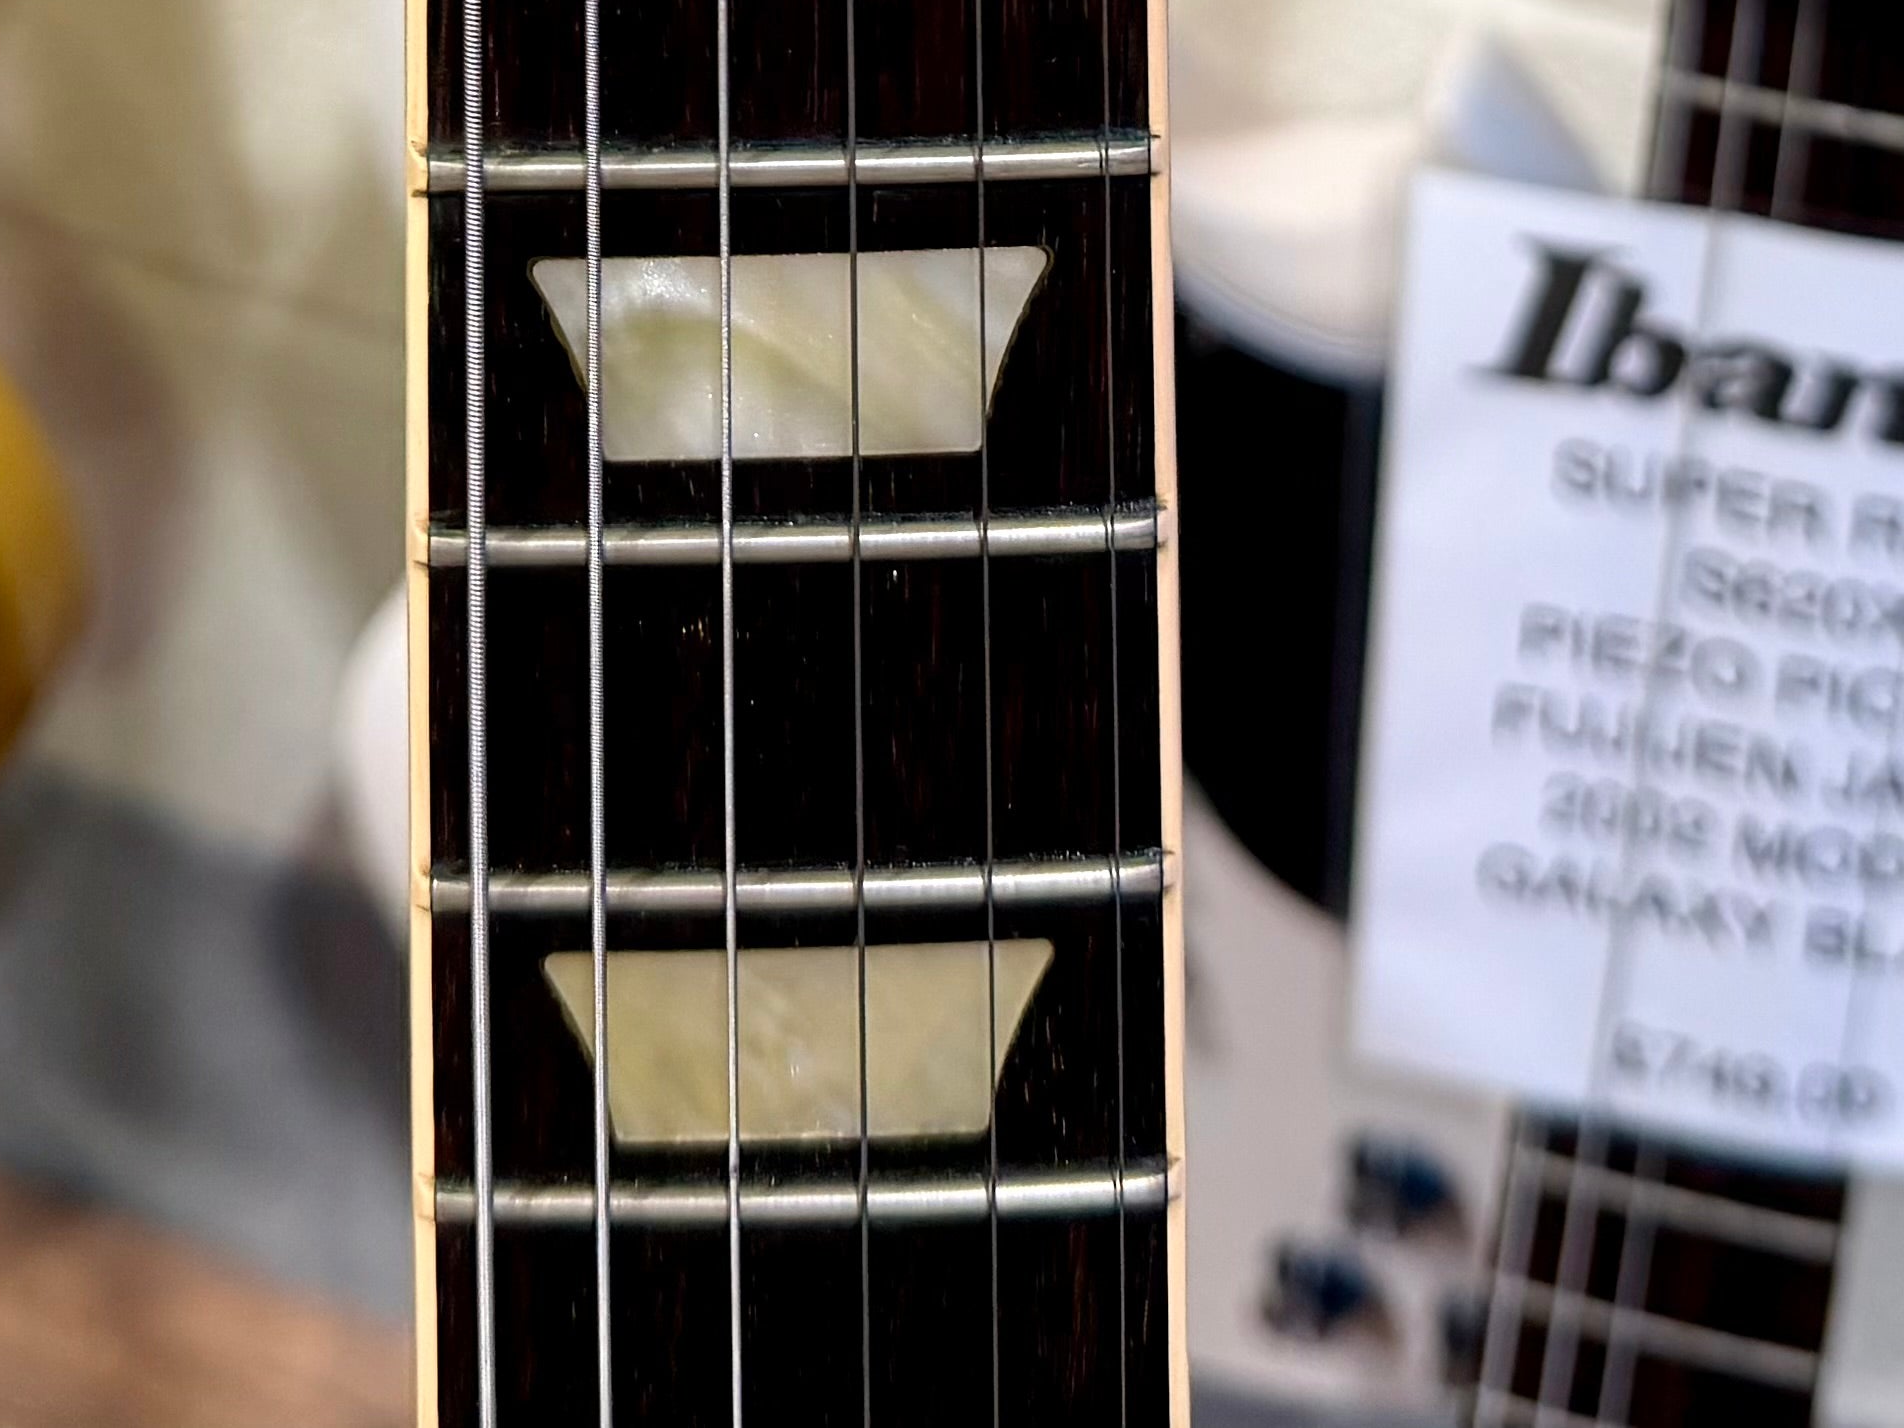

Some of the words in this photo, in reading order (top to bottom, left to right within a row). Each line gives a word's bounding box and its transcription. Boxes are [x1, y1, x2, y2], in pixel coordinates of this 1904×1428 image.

[1548, 434, 1836, 548] SUPER
[1516, 600, 1762, 706] PIEZO
[1474, 842, 1782, 952] GALAXY
